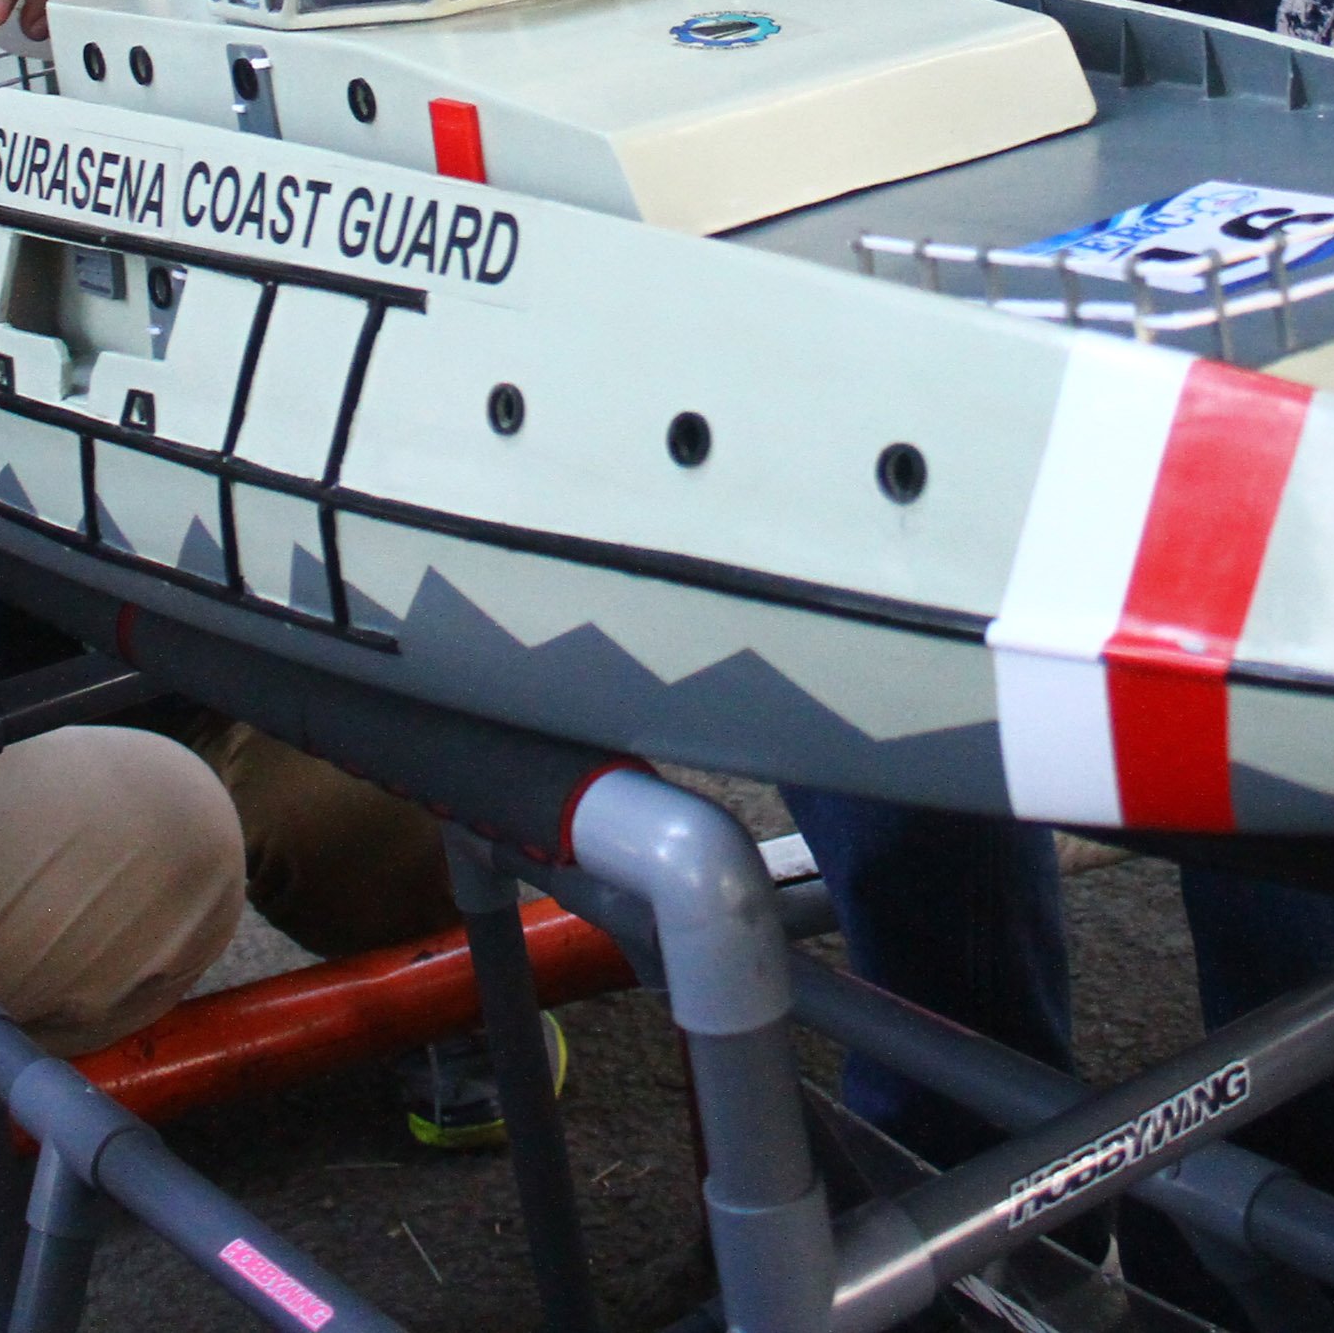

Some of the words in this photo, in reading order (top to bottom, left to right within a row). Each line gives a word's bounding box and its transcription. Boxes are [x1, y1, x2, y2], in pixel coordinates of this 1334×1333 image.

[182, 160, 332, 248] COAST
[338, 186, 520, 286] GUARD
[1008, 1058, 1250, 1230] HOBBYWING
[219, 1238, 333, 1331] HOBBYWING
